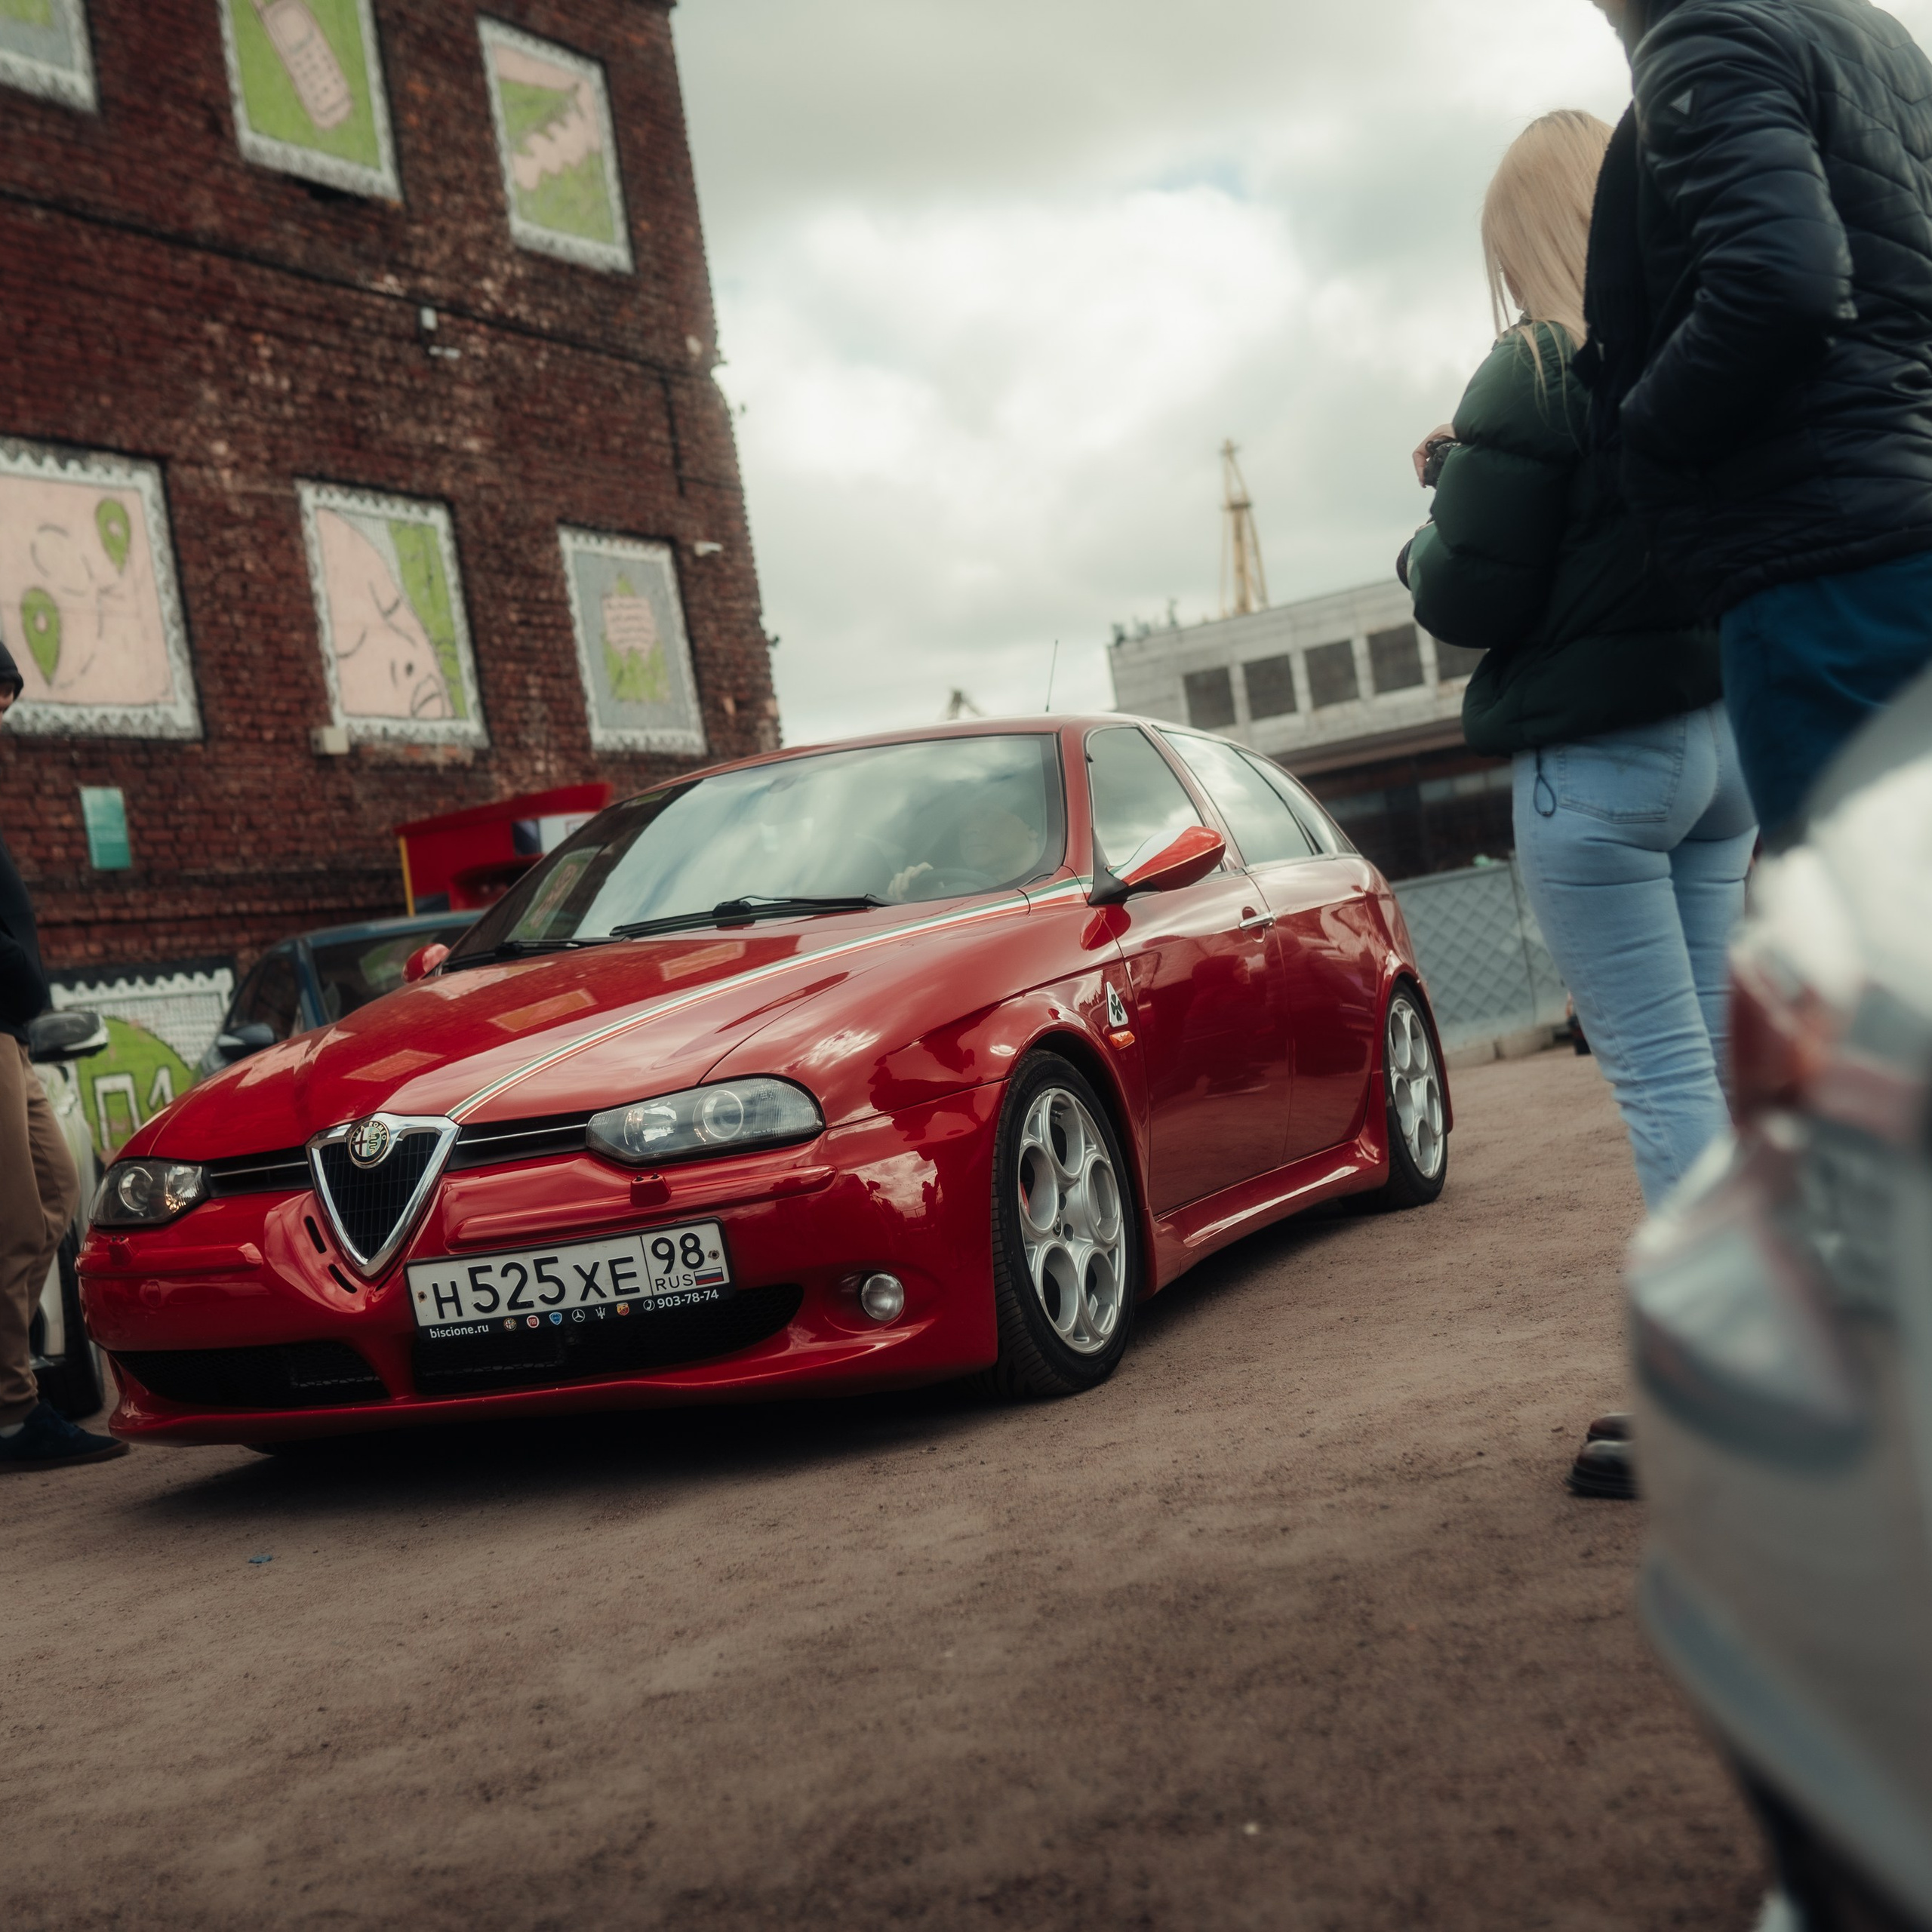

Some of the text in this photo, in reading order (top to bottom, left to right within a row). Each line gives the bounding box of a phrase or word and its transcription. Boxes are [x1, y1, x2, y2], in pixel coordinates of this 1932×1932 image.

[368, 1121, 386, 1140] ROMEO
[651, 1232, 705, 1275] 98
[655, 1273, 694, 1291] RUS
[429, 1324, 490, 1339] biscione.ru
[657, 1290, 719, 1309] 903-78-74
